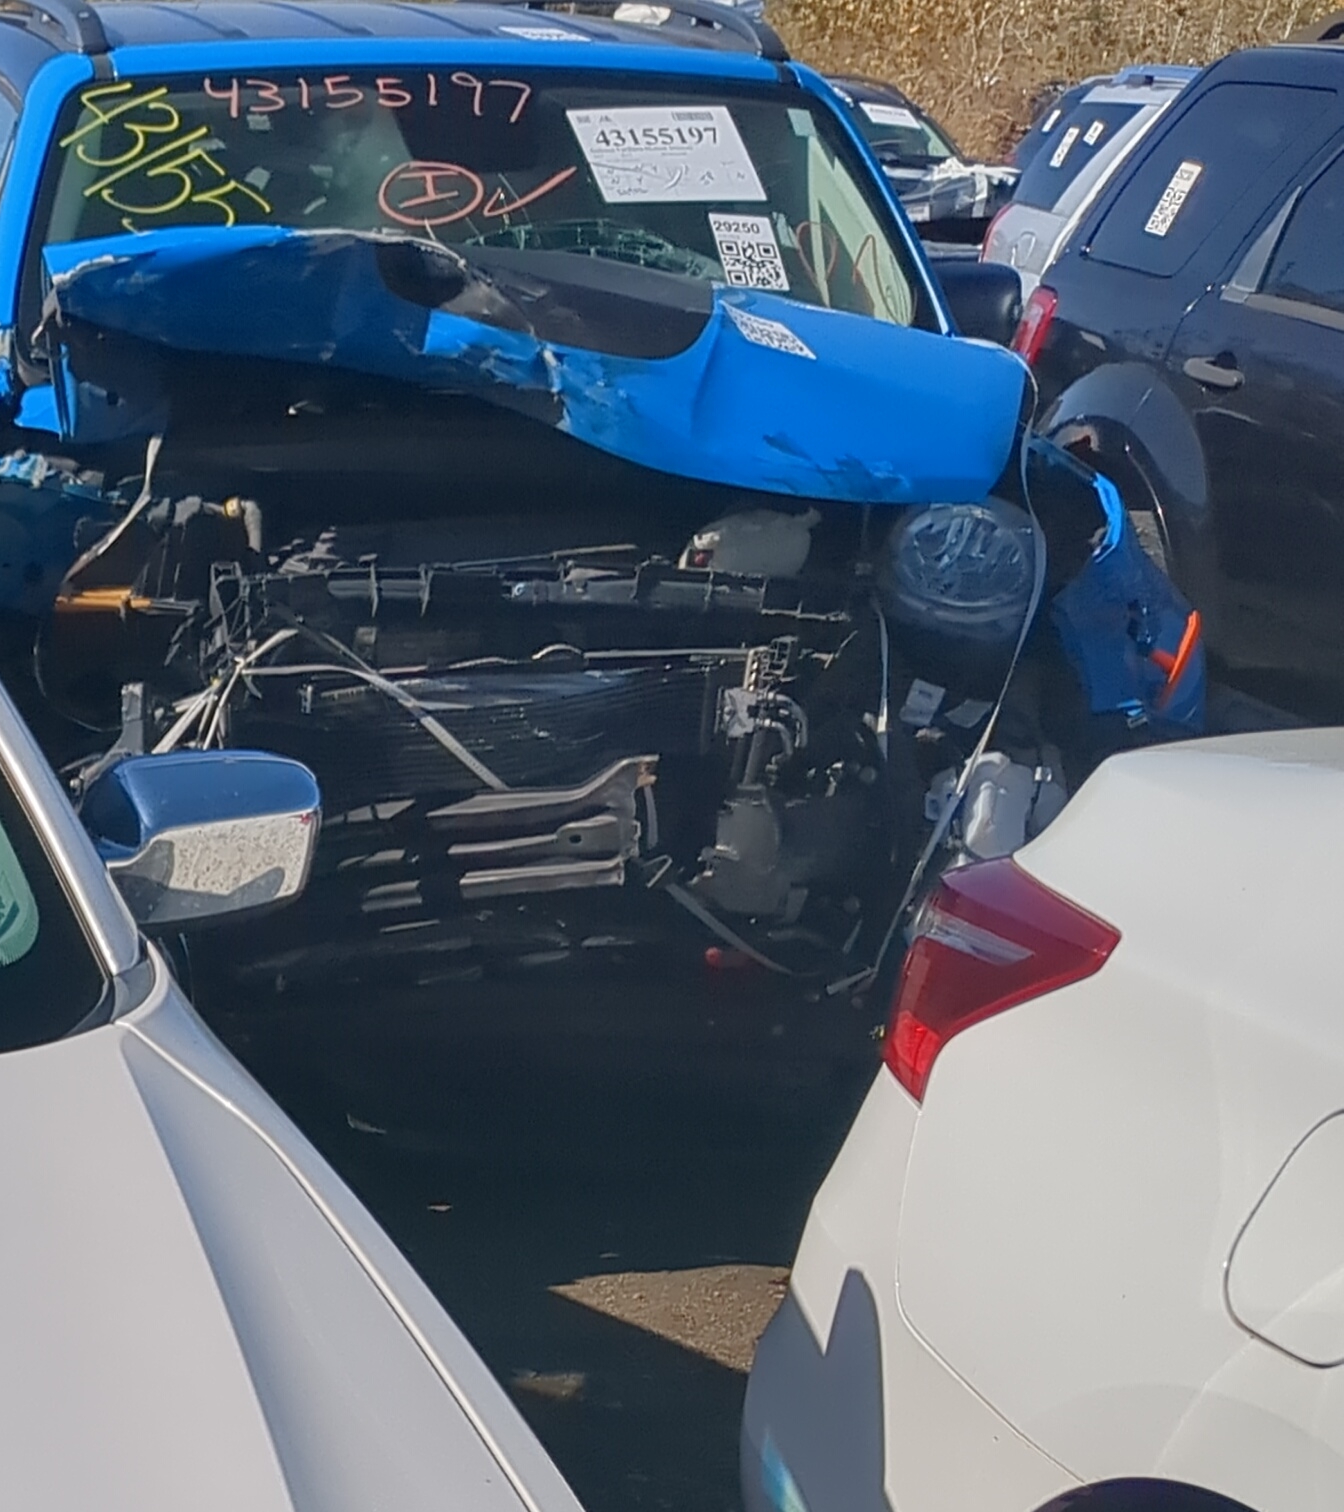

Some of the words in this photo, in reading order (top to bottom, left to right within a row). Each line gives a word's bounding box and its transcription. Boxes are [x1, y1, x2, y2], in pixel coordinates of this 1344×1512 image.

[204, 74, 531, 122] 43155197
[596, 127, 718, 147] 43155197
[713, 220, 760, 234] 29250
